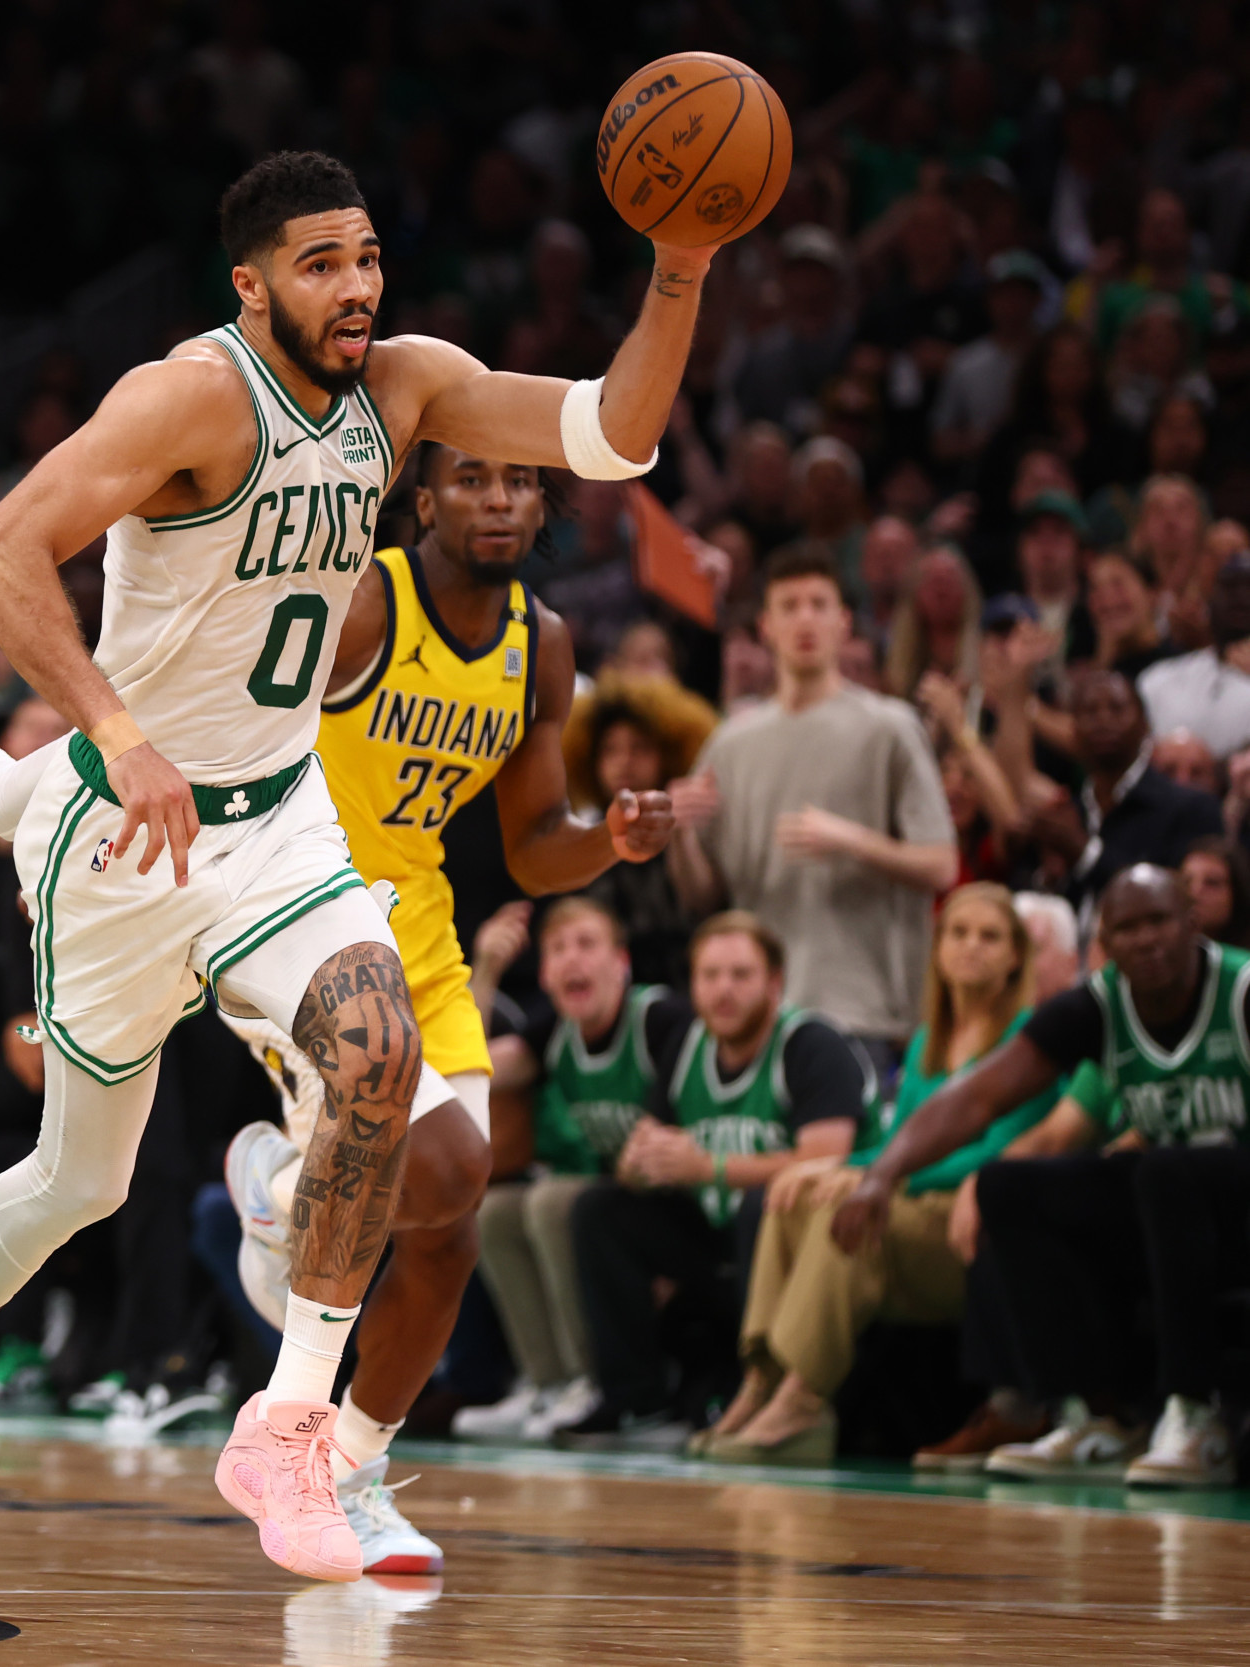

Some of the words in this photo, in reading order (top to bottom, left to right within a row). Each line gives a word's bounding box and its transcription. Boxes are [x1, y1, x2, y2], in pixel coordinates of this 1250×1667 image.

[343, 446, 376, 464] PRINT
[234, 482, 380, 581] CELICS
[247, 594, 329, 709] 0
[366, 687, 519, 762] INDIANA
[380, 757, 474, 832] 23
[296, 1173, 331, 1202] UKE
